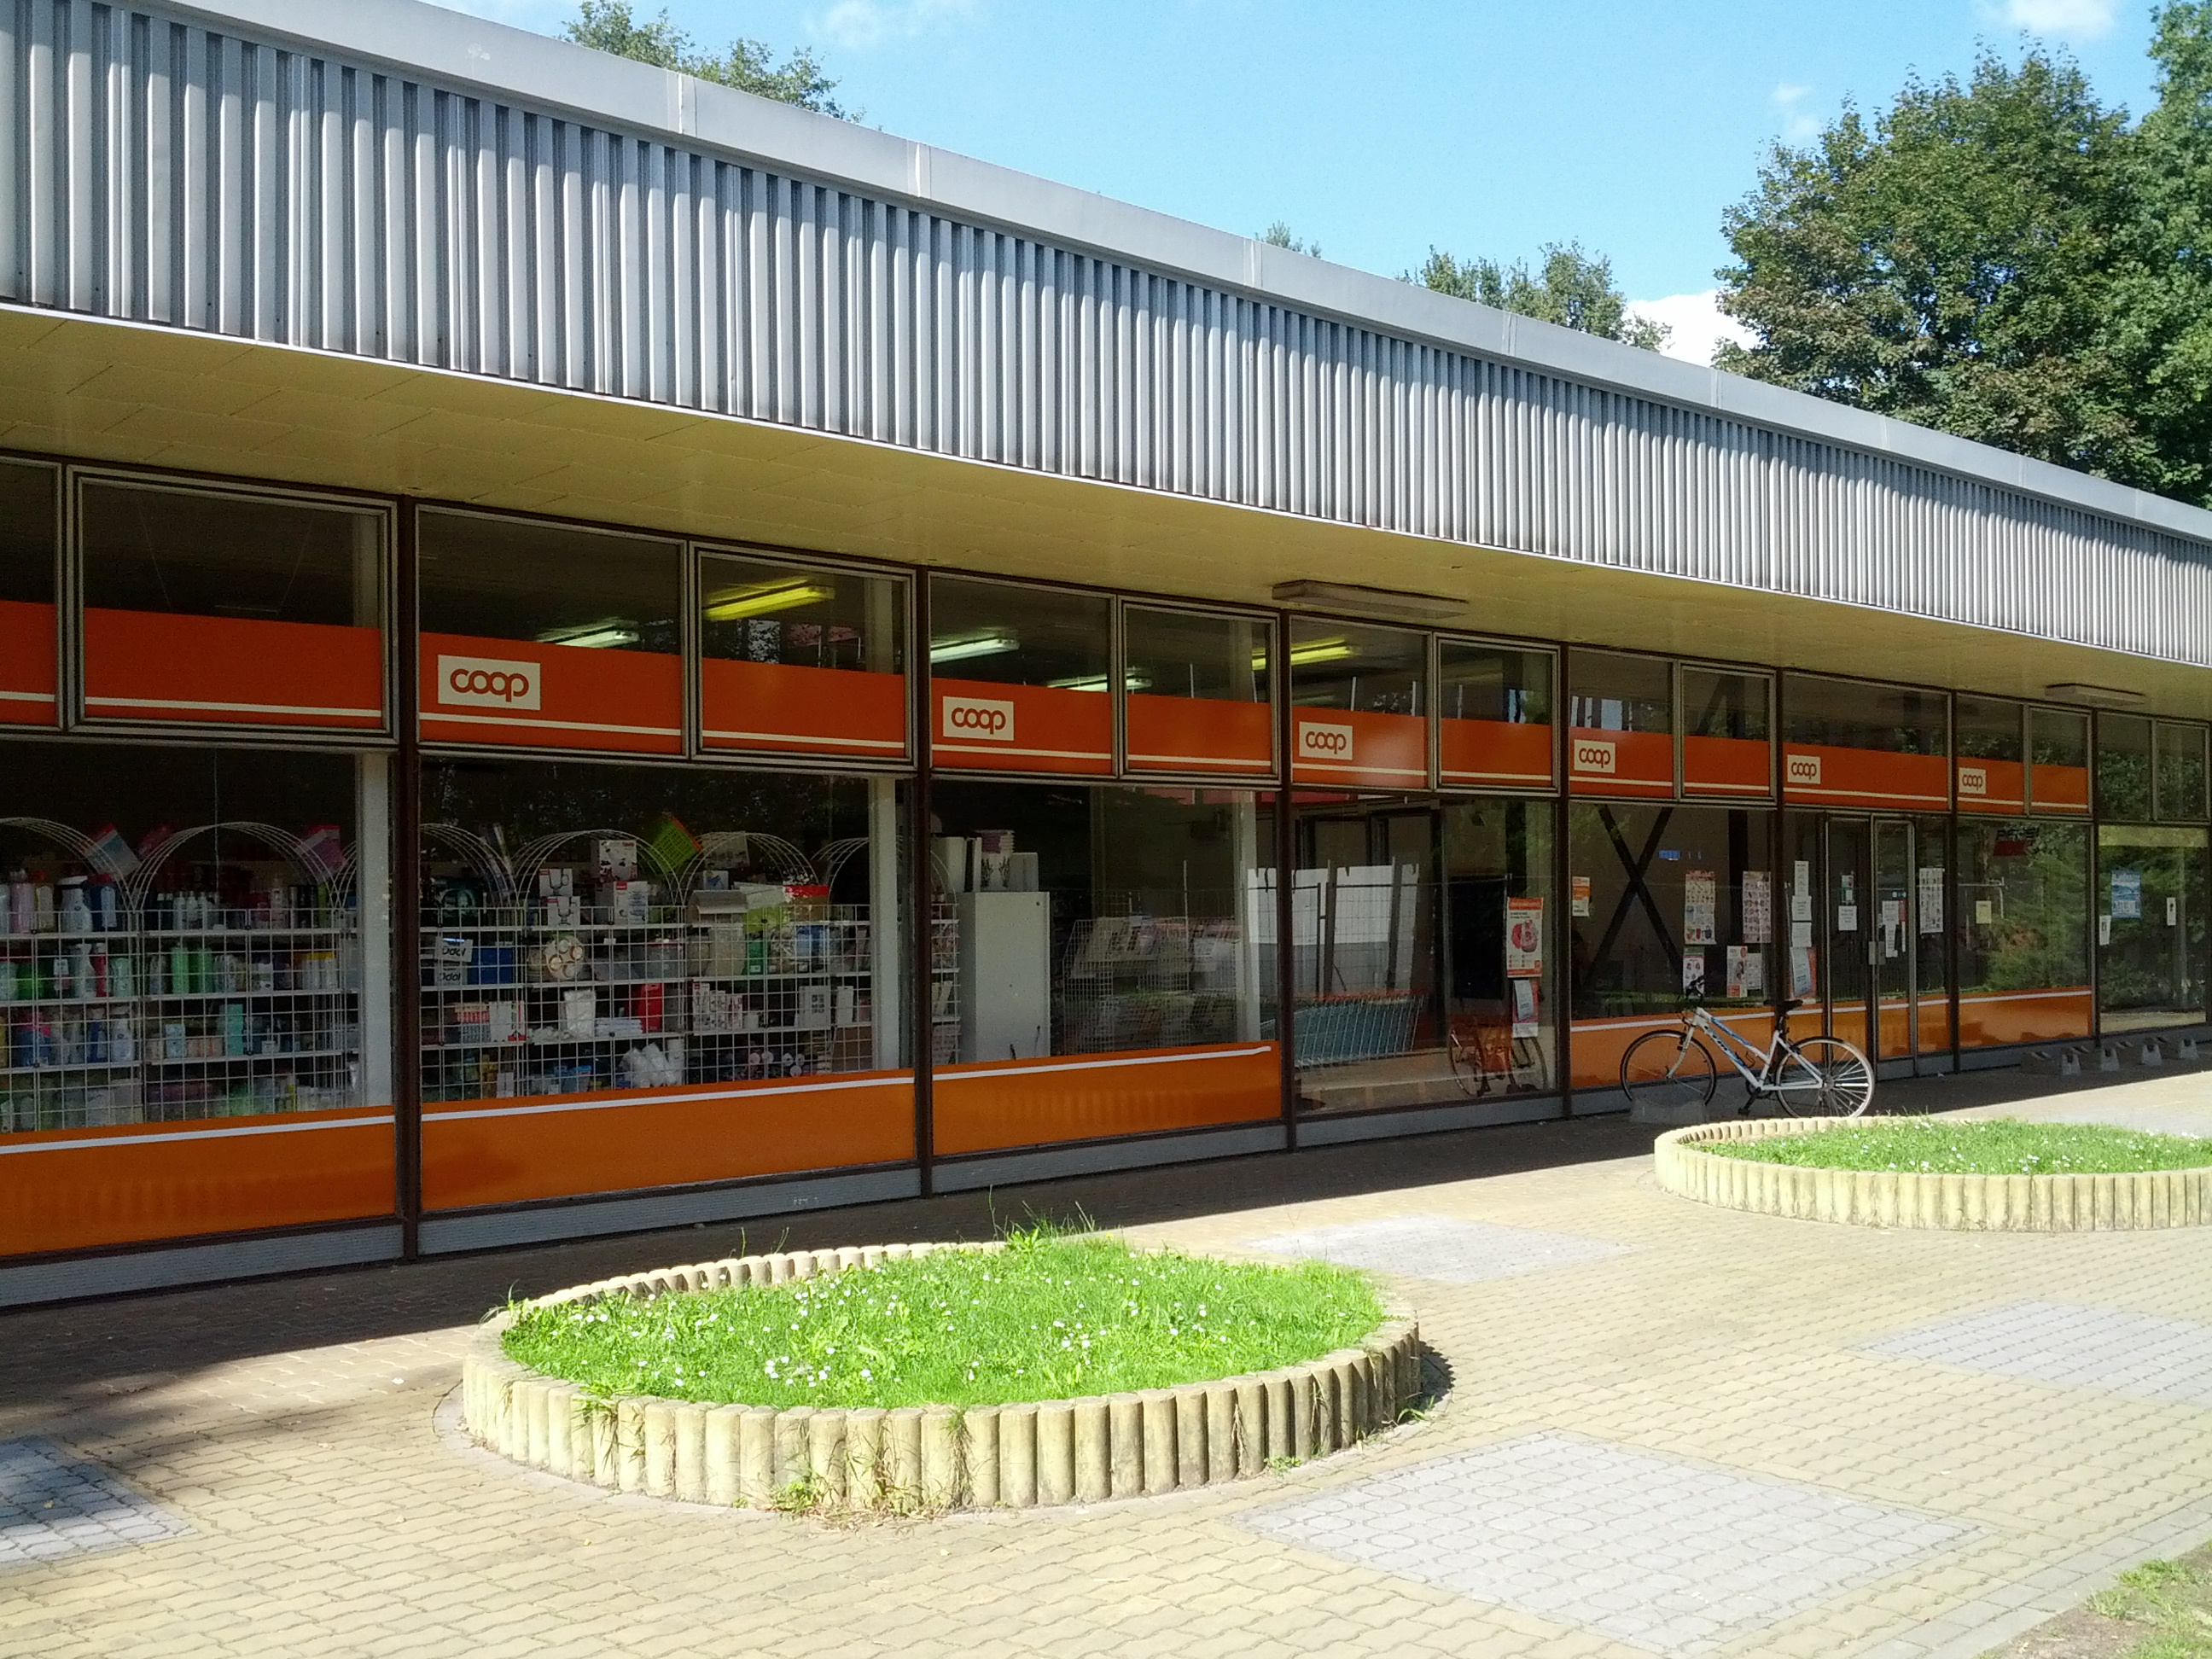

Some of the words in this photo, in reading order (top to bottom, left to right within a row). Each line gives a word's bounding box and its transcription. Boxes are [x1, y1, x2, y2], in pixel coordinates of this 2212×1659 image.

[449, 668, 530, 702] coop
[951, 707, 1007, 735] coop
[1305, 731, 1347, 754] coop
[1578, 748, 1611, 767] coop
[1790, 761, 1818, 780] coop
[1962, 773, 1983, 790] coop
